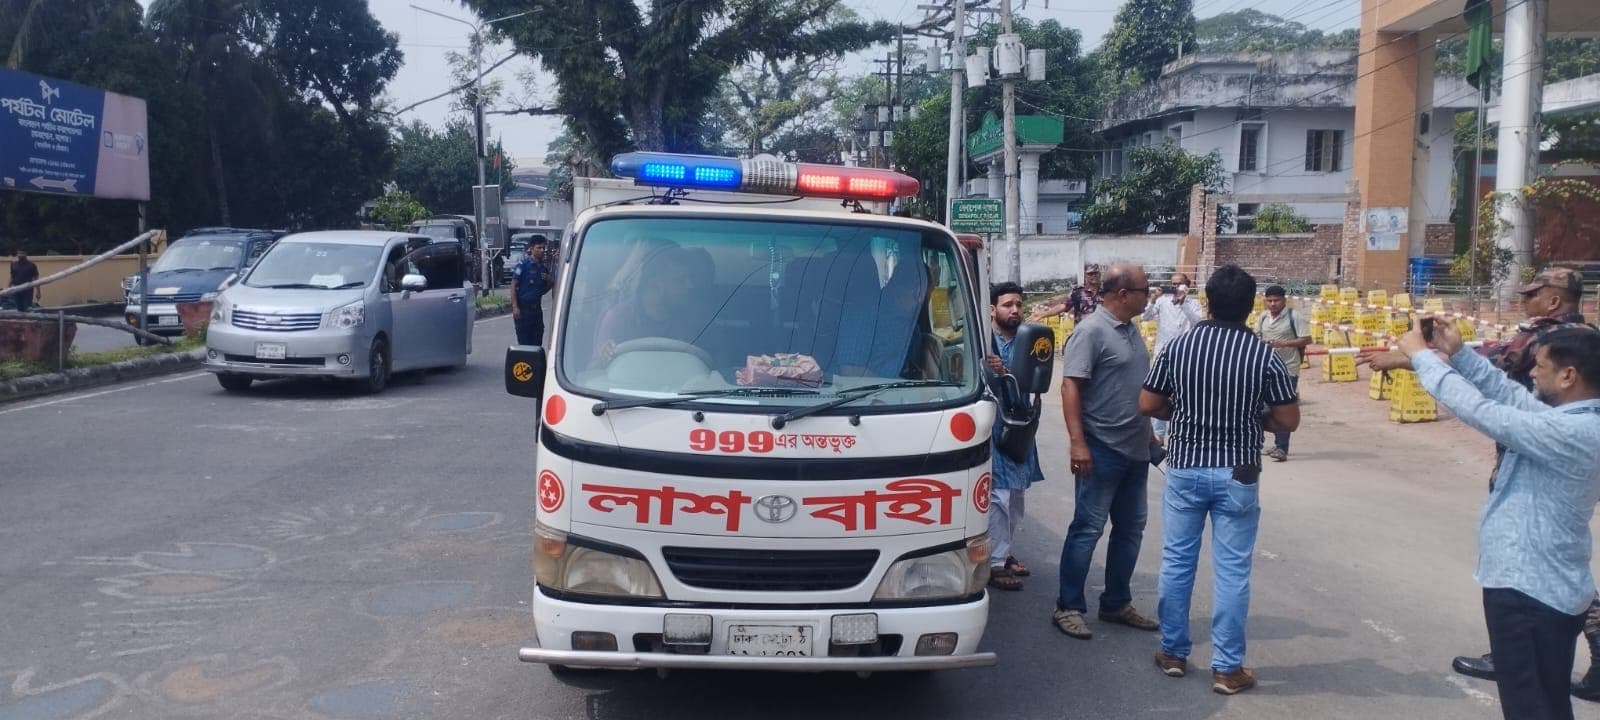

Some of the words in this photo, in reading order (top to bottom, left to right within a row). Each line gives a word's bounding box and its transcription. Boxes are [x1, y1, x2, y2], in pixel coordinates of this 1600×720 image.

[0, 97, 46, 120] পর্যটন
[50, 107, 95, 128] মোটেল
[582, 483, 752, 532] লাশ
[802, 478, 962, 531] বাহী
